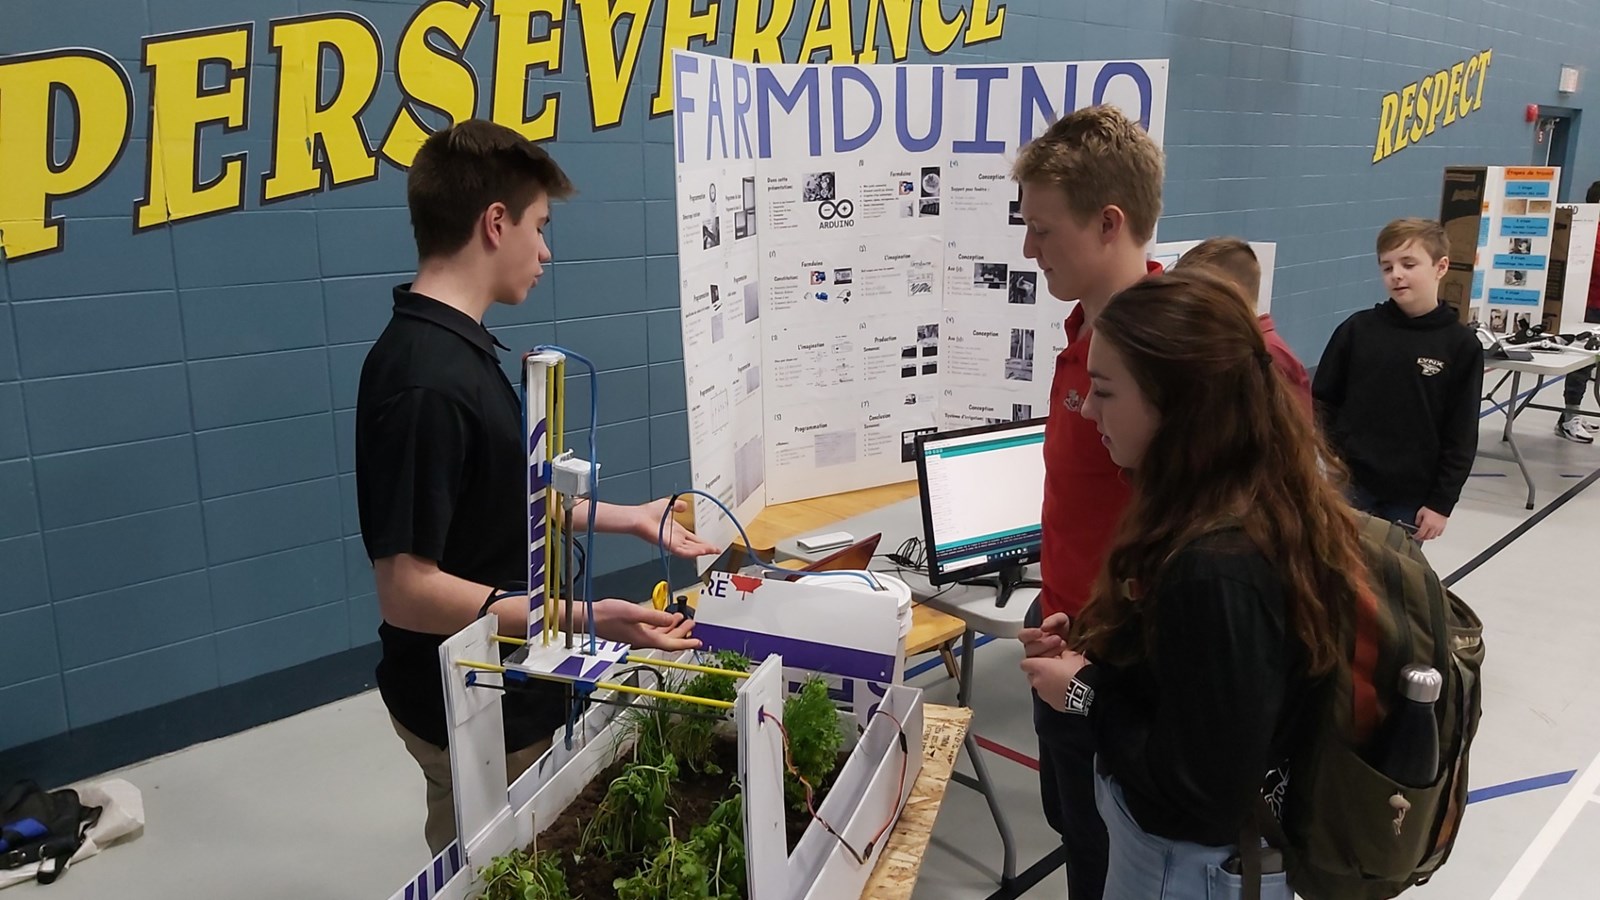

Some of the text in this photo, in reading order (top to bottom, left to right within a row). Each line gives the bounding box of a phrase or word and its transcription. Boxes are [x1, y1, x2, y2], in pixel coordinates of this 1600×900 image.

[1372, 48, 1492, 164] RESPECT
[676, 62, 1153, 163] FARMDUINO
[978, 173, 1005, 181] Conception
[819, 220, 855, 229] ARDUINO
[972, 330, 998, 338] Conception
[874, 336, 896, 344] Production
[798, 342, 824, 350] L'imagination
[1416, 357, 1444, 368] LYNX
[968, 404, 994, 412] Conception
[868, 413, 890, 422] Conclusion
[794, 423, 828, 433] Programmation
